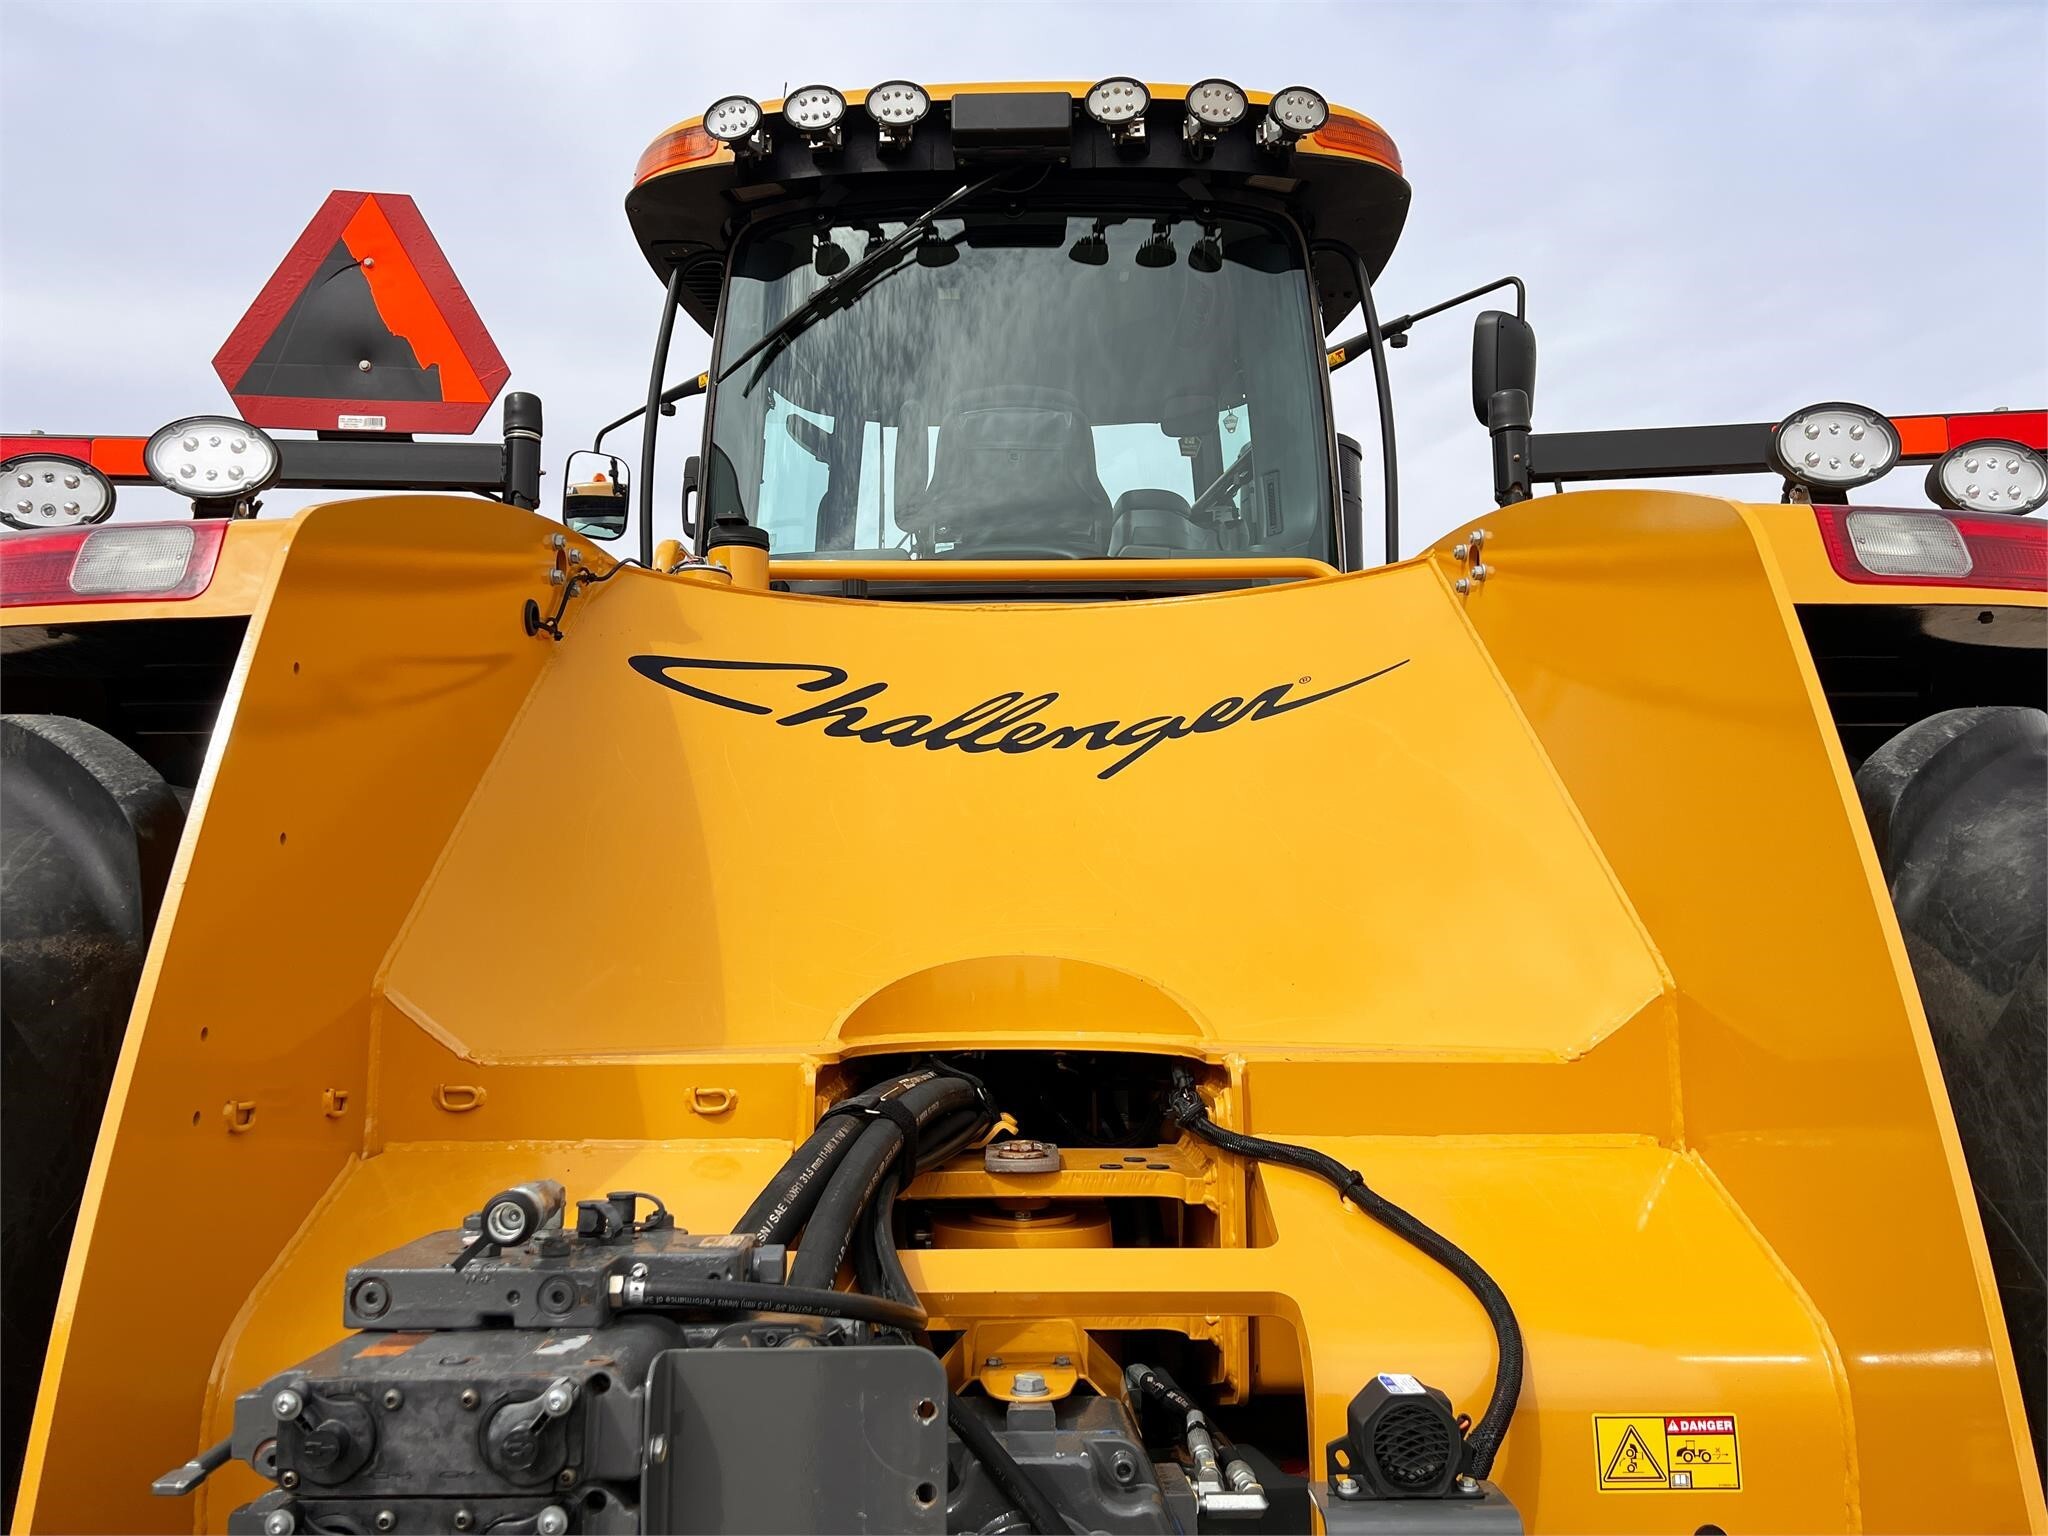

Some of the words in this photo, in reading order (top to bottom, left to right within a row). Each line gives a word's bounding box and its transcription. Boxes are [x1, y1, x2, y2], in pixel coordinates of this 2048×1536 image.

[628, 654, 1410, 780] Challenger
[757, 1225, 771, 1245] SN
[769, 1203, 788, 1223] SAE
[784, 1182, 803, 1205] 100R1
[656, 1295, 664, 1304] of
[665, 1295, 716, 1306] Performance
[1680, 1420, 1733, 1431] DANGER
